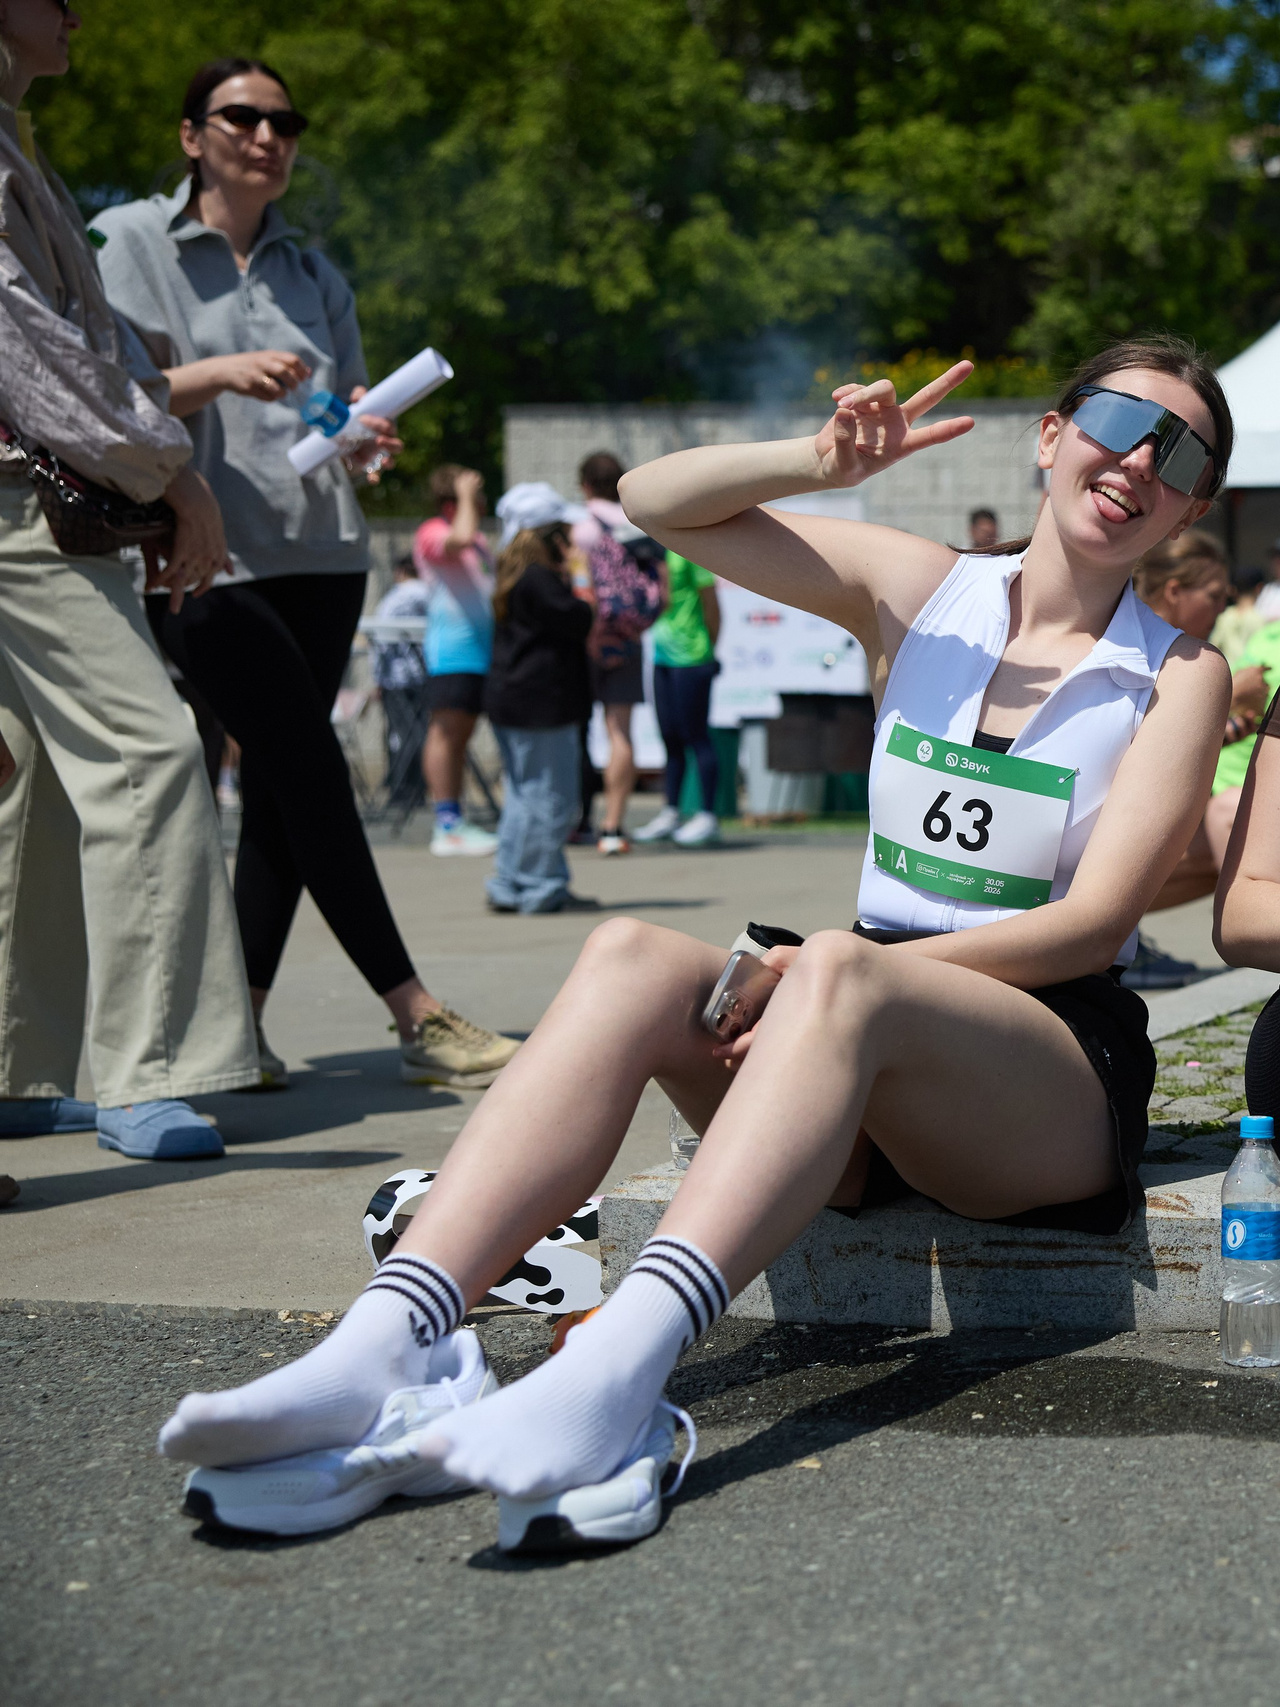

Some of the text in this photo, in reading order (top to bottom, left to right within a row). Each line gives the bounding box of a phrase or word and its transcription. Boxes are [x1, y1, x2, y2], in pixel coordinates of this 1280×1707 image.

[959, 757, 991, 775] Звук
[922, 790, 993, 852] 63
[985, 877, 1005, 888] 30.05
[984, 885, 1001, 895] 2026
